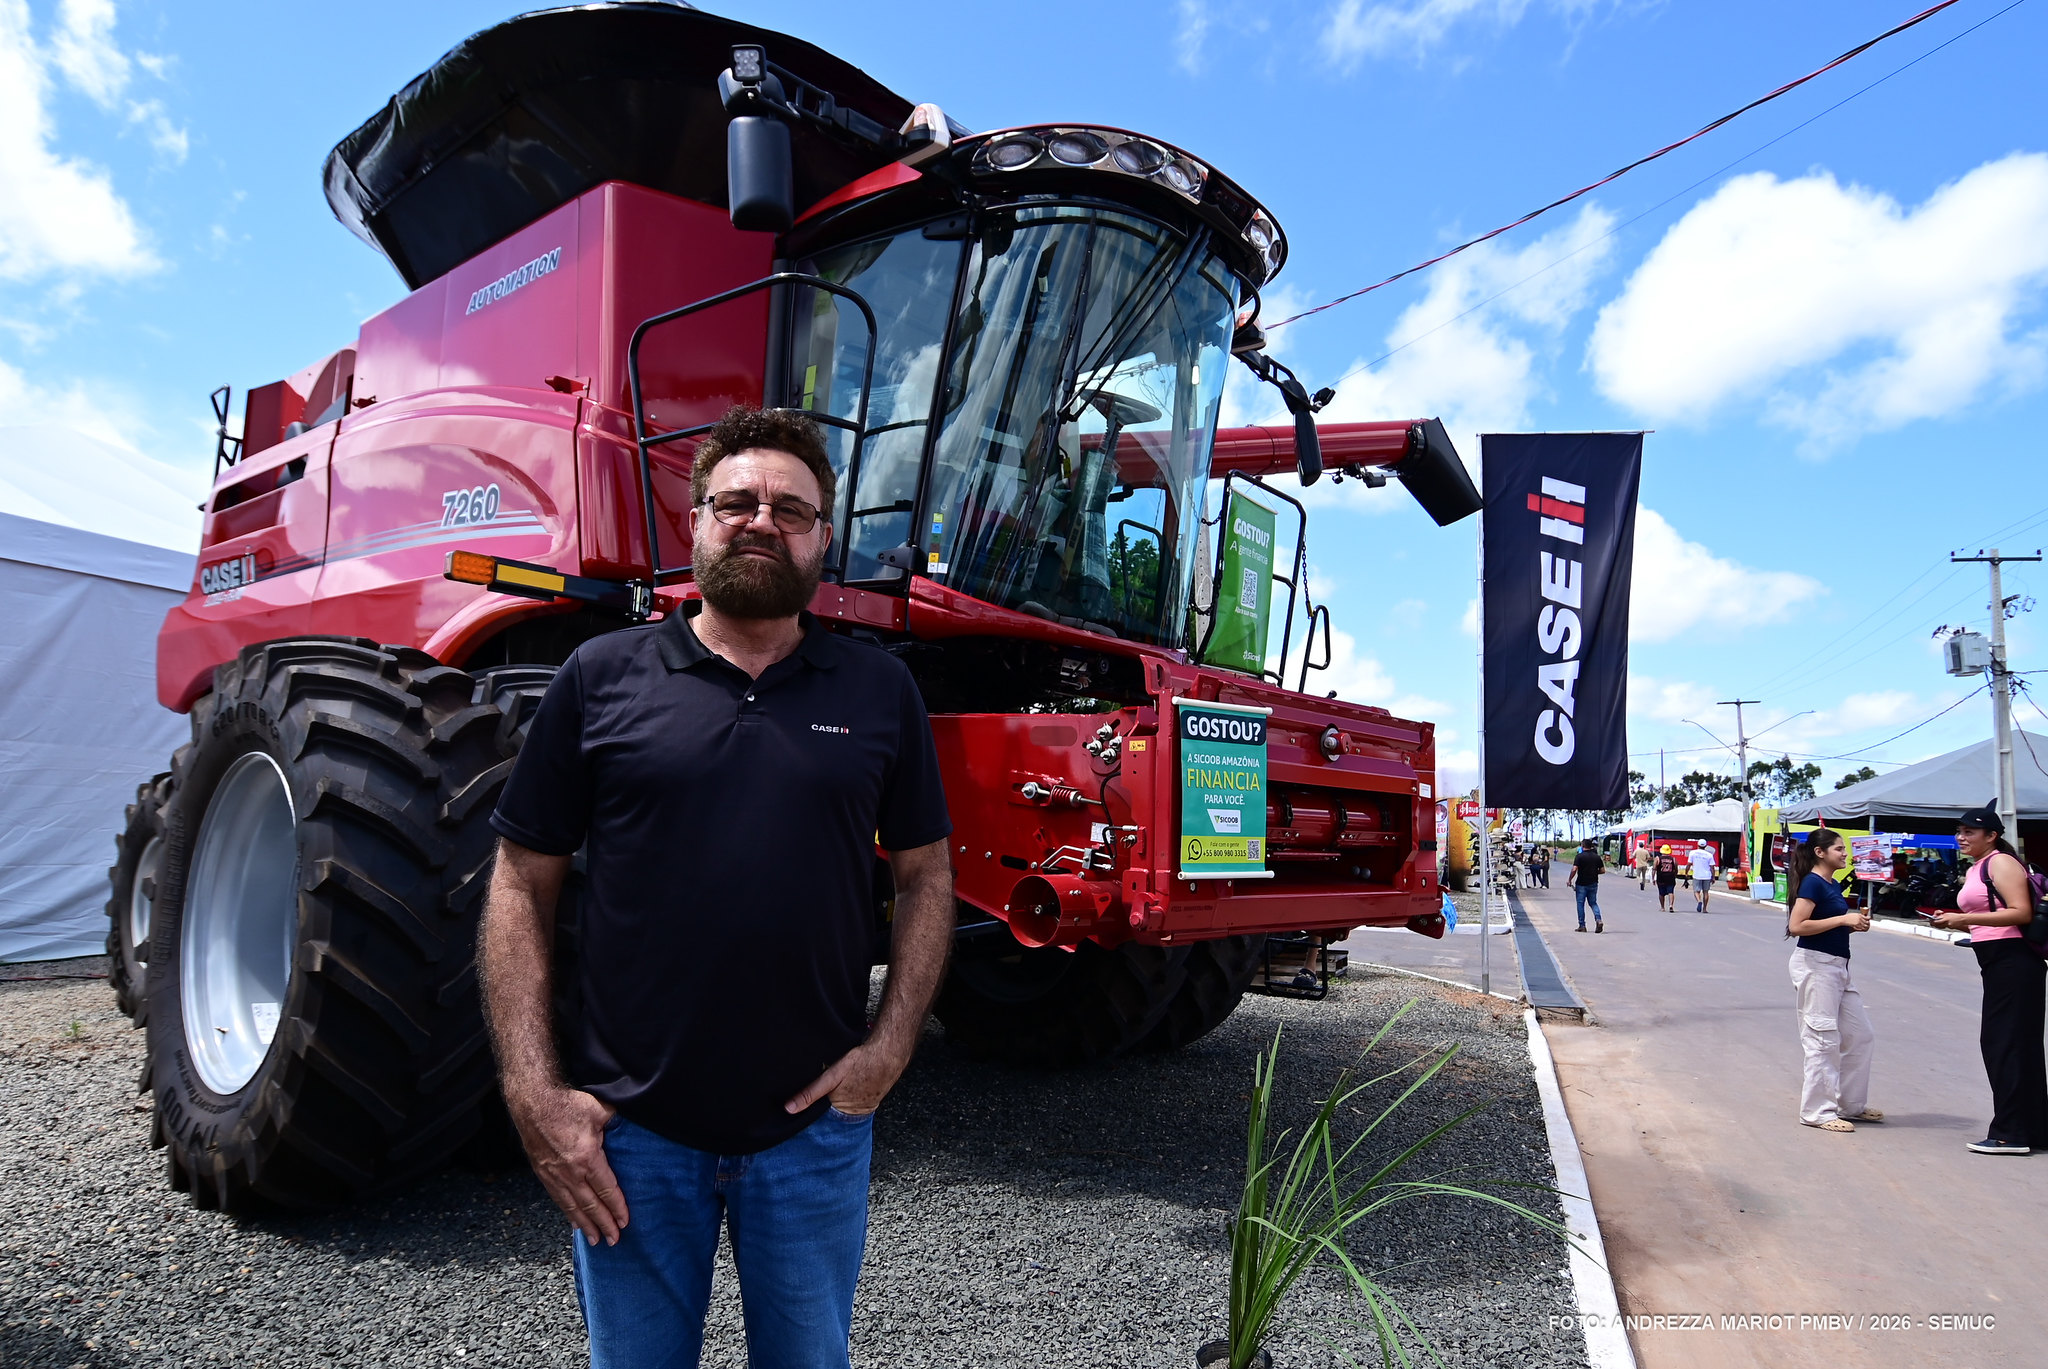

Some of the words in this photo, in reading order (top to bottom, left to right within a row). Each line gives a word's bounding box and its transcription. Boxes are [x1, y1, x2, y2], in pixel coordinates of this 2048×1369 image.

[465, 246, 562, 316] AUTOMATION
[441, 482, 500, 527] 7260
[1233, 517, 1271, 549] GOSTOU?
[1229, 540, 1238, 552] A
[200, 558, 241, 595] CASE
[1534, 550, 1583, 766] CASE
[810, 723, 840, 734] CASE
[1186, 715, 1262, 742] GOSTOU?
[1186, 753, 1193, 763] A
[1193, 753, 1221, 765] SICOOB
[1221, 755, 1261, 768] AMAZÔNIA
[1186, 768, 1261, 792] FINANCIA
[1204, 793, 1223, 804] PARA
[1219, 816, 1239, 824] SICOOB
[1203, 849, 1213, 858] +55
[1234, 849, 1248, 858] 3315
